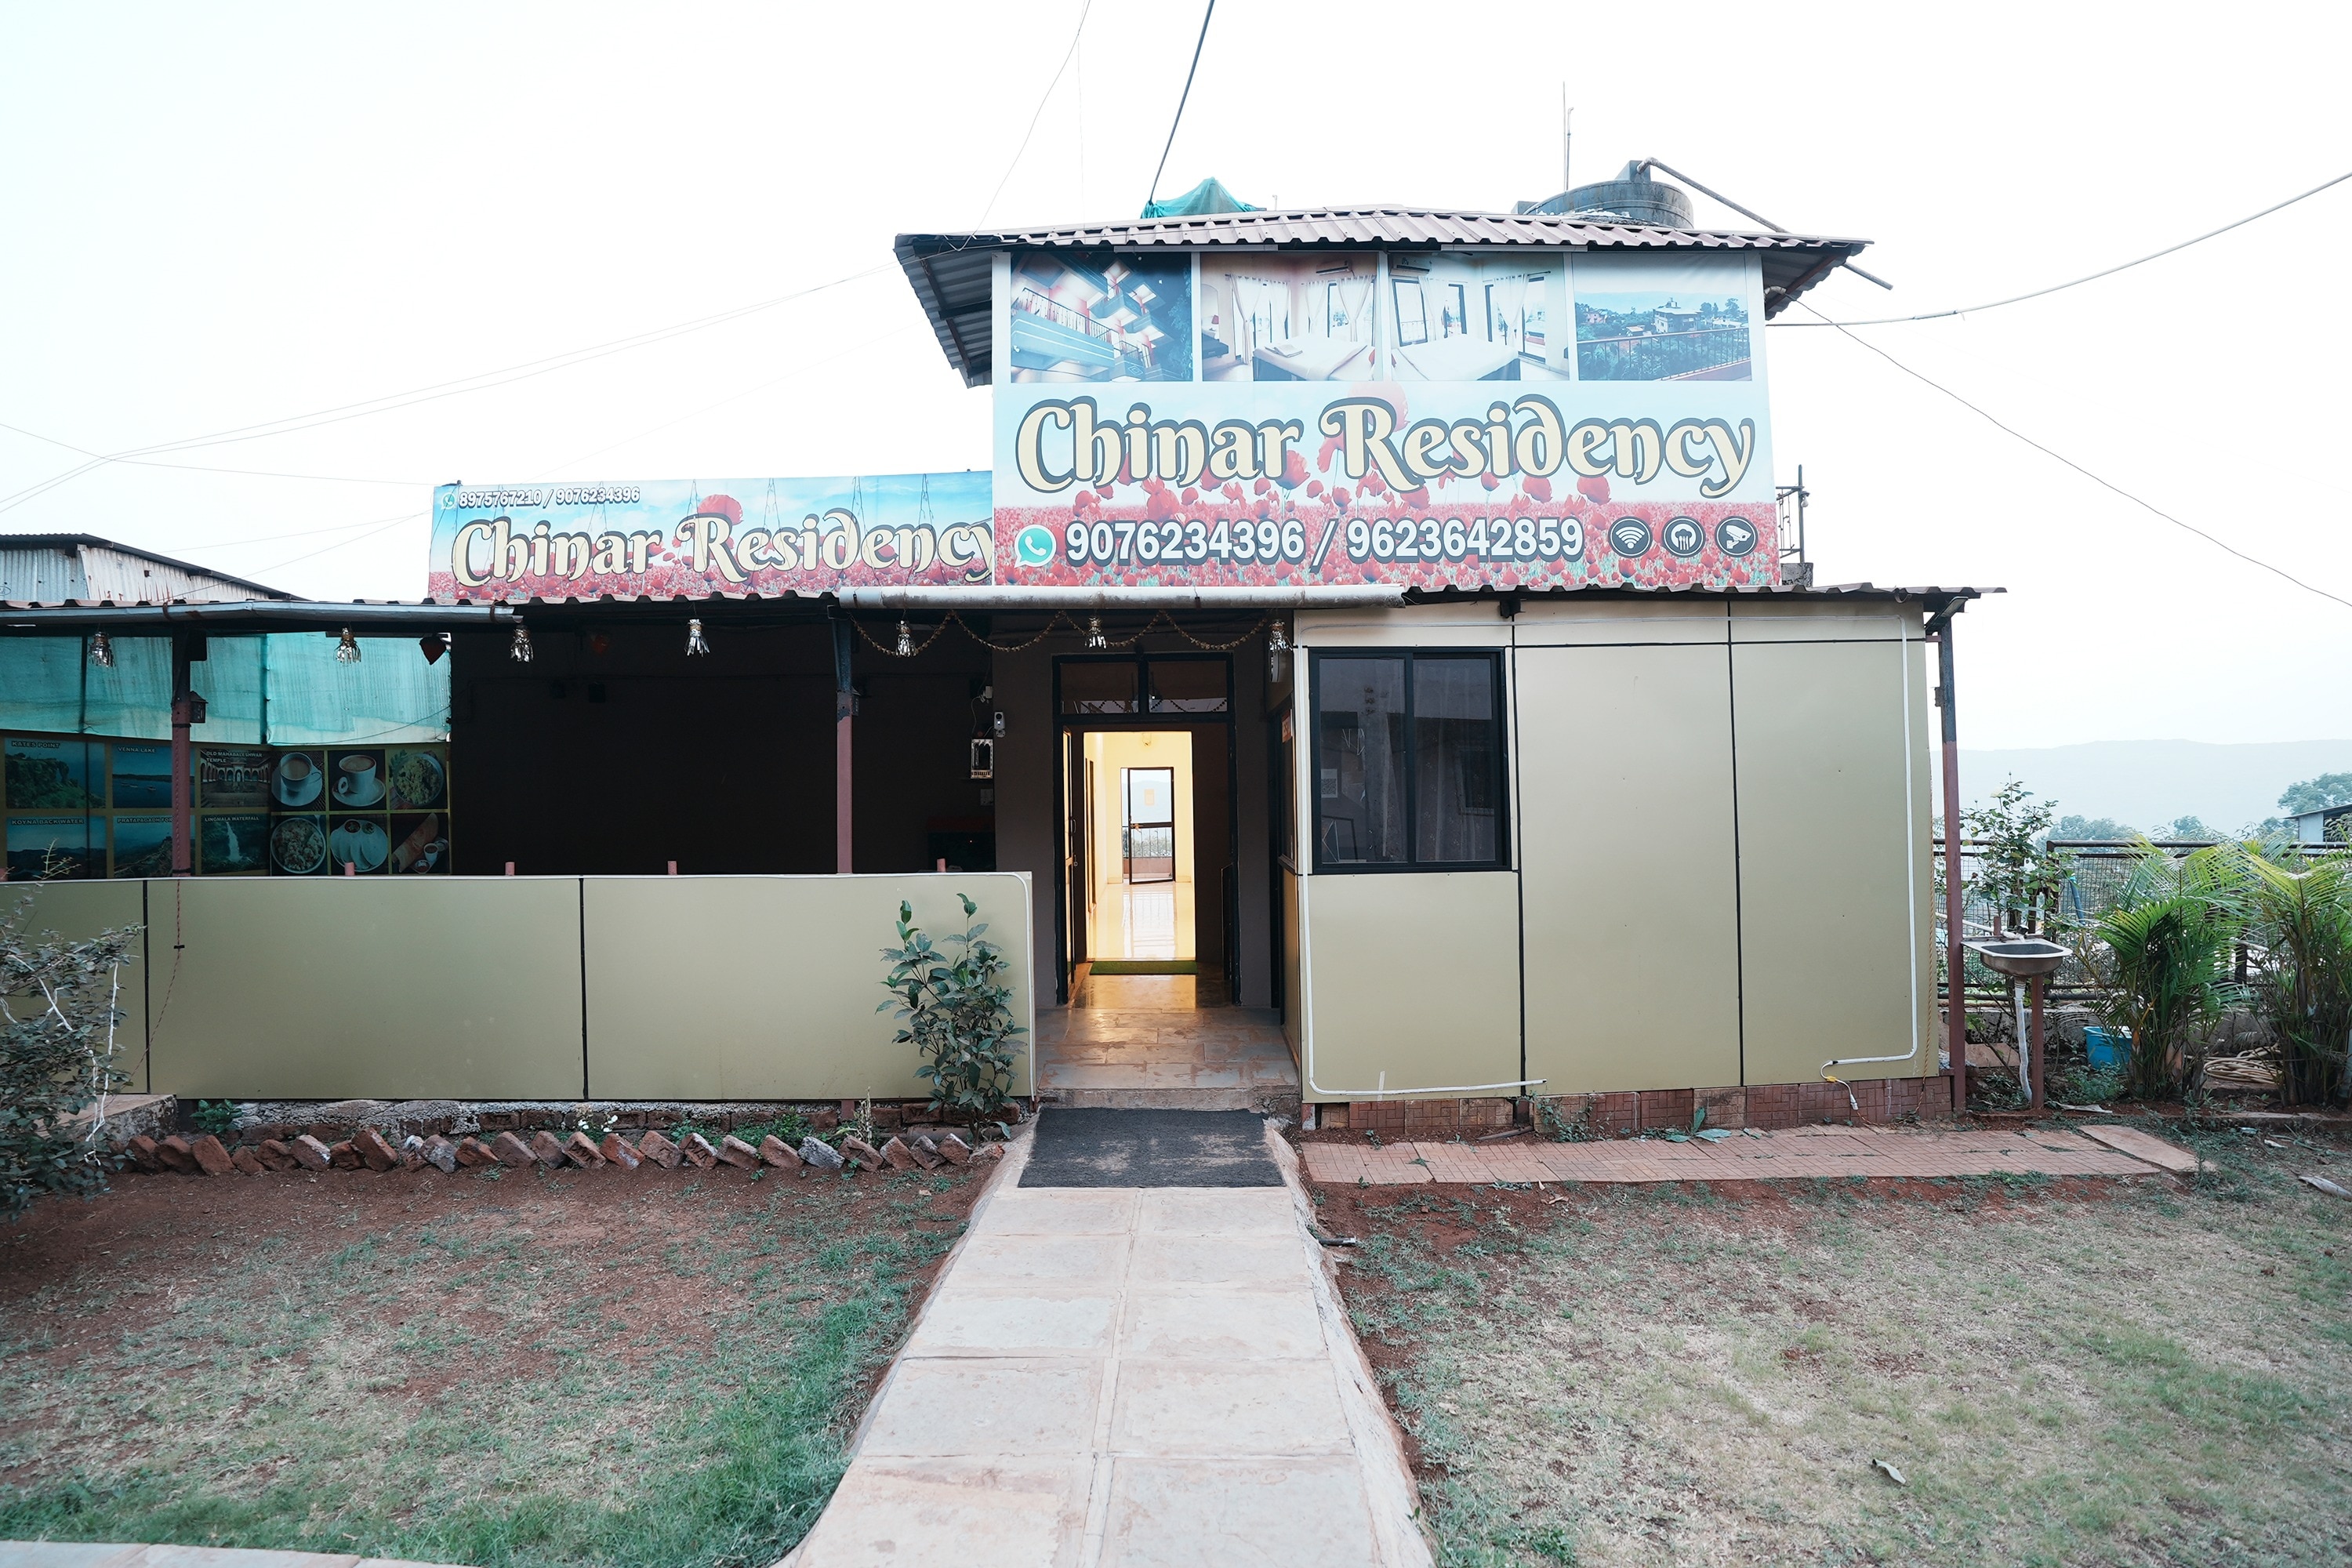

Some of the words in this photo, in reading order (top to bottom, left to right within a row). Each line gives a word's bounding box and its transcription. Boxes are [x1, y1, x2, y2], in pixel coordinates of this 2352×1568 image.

[1016, 395, 1304, 493] Chinar
[1318, 393, 1756, 498] Residency
[459, 490, 542, 509] 8975767210
[543, 489, 554, 509] /
[556, 486, 641, 505] 9076234396
[452, 515, 662, 586] Chinar
[675, 507, 993, 583] Residency
[1065, 518, 1305, 568] 9076234396
[1309, 518, 1338, 573] /
[1346, 516, 1584, 564] 9623642859
